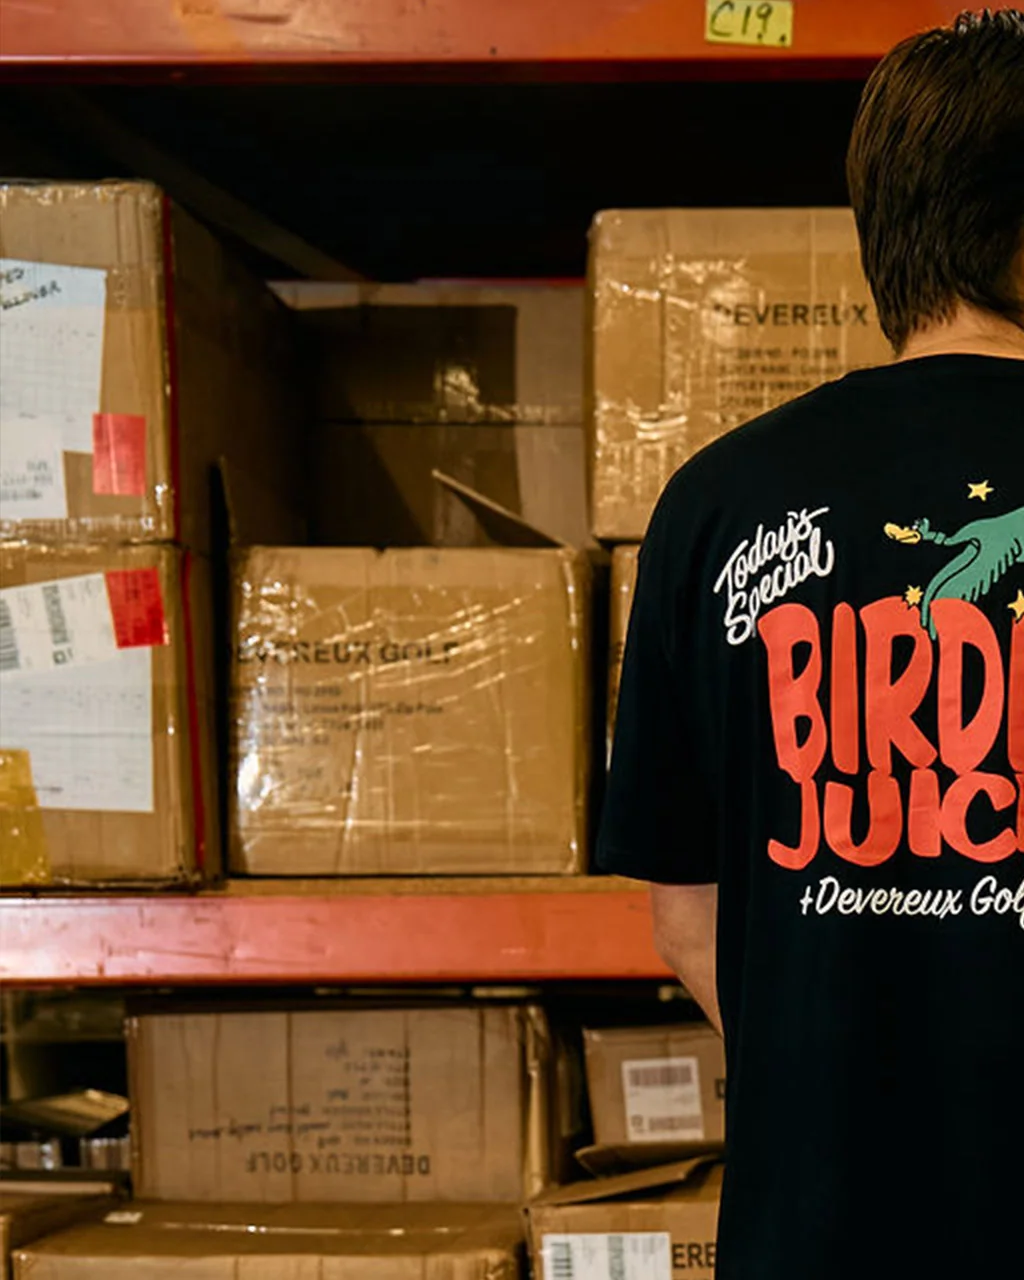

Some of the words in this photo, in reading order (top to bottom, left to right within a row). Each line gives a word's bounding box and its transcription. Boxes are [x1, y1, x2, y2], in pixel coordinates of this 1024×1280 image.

[714, 303, 868, 326] EVEREUX
[713, 507, 830, 594] Today's
[723, 526, 835, 645] Special
[808, 875, 963, 919] Devereux
